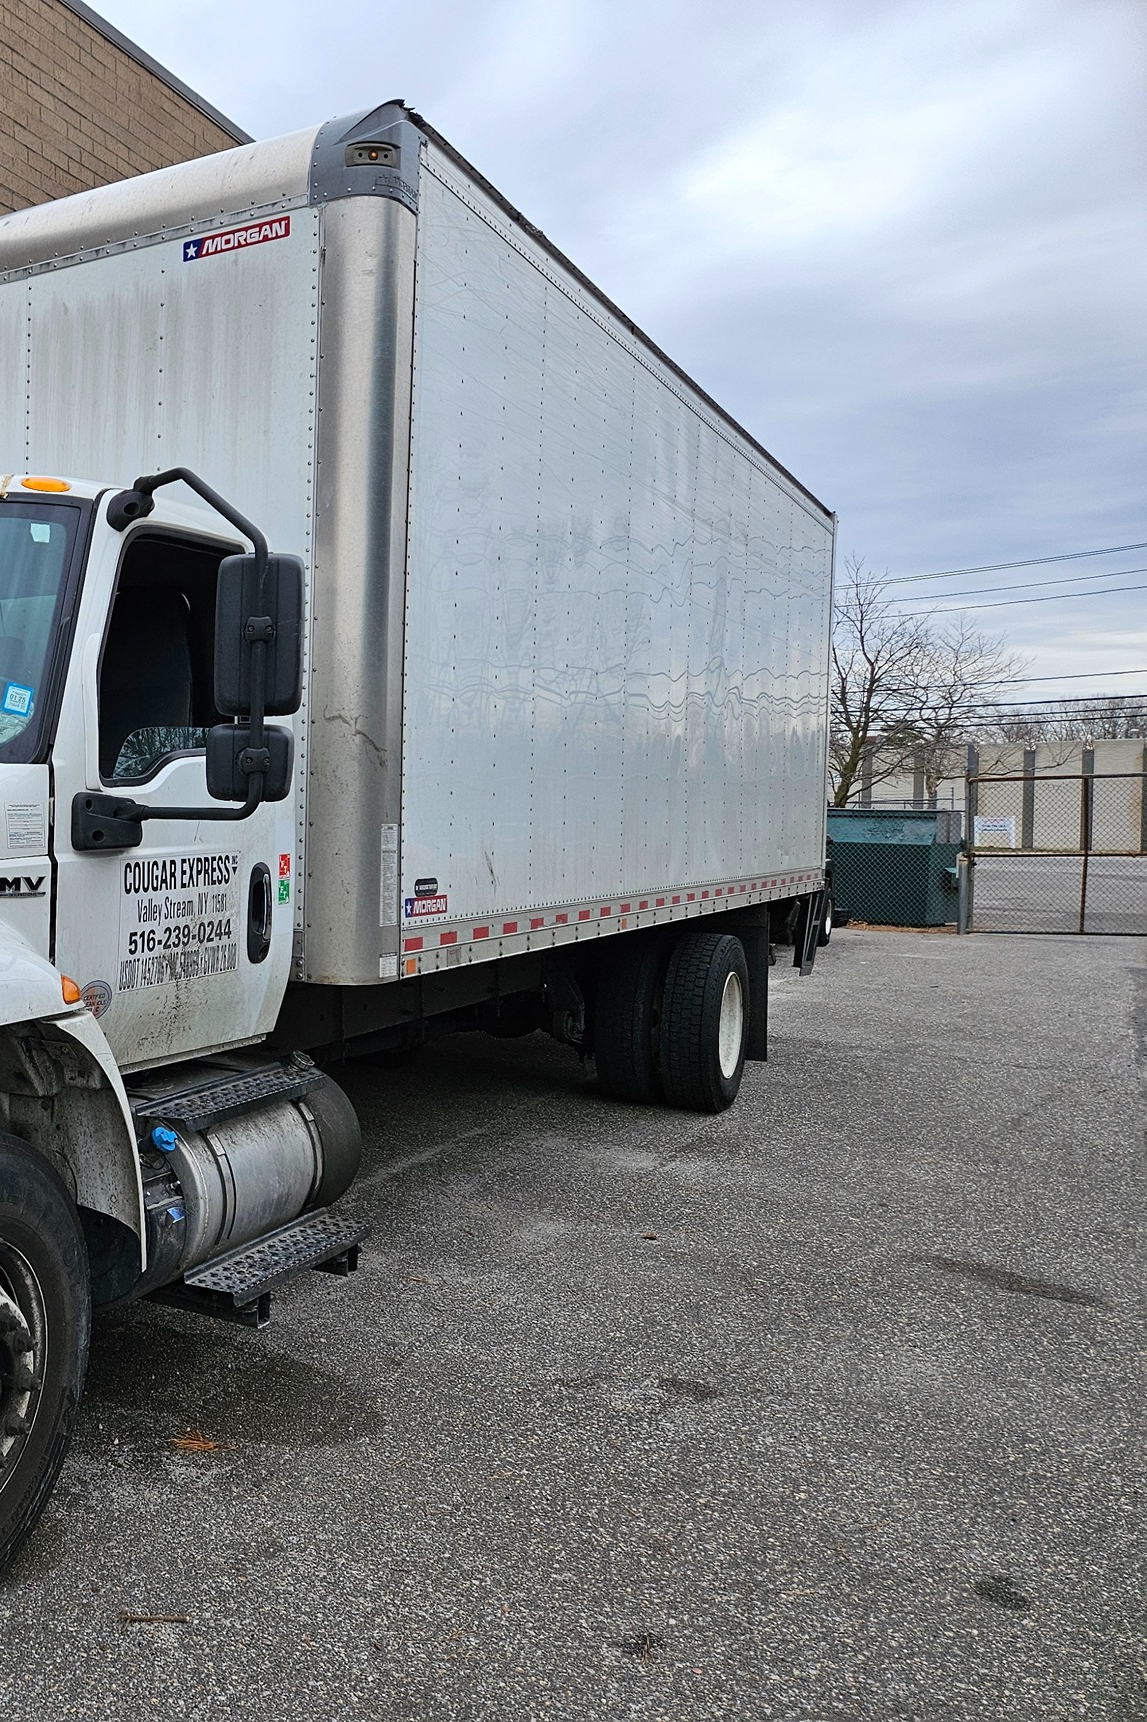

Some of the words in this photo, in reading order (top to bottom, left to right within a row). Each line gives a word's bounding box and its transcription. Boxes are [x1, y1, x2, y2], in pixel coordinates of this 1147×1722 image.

[201, 220, 286, 255] MORGAN
[124, 859, 177, 894] COUGAR
[180, 854, 230, 889] EXPRESS
[137, 898, 163, 926] Valley
[164, 896, 196, 918] Stream,
[197, 892, 209, 916] NY
[212, 893, 227, 914] 11581
[413, 898, 446, 914] MORGAN
[128, 918, 232, 955] 516-239-0244
